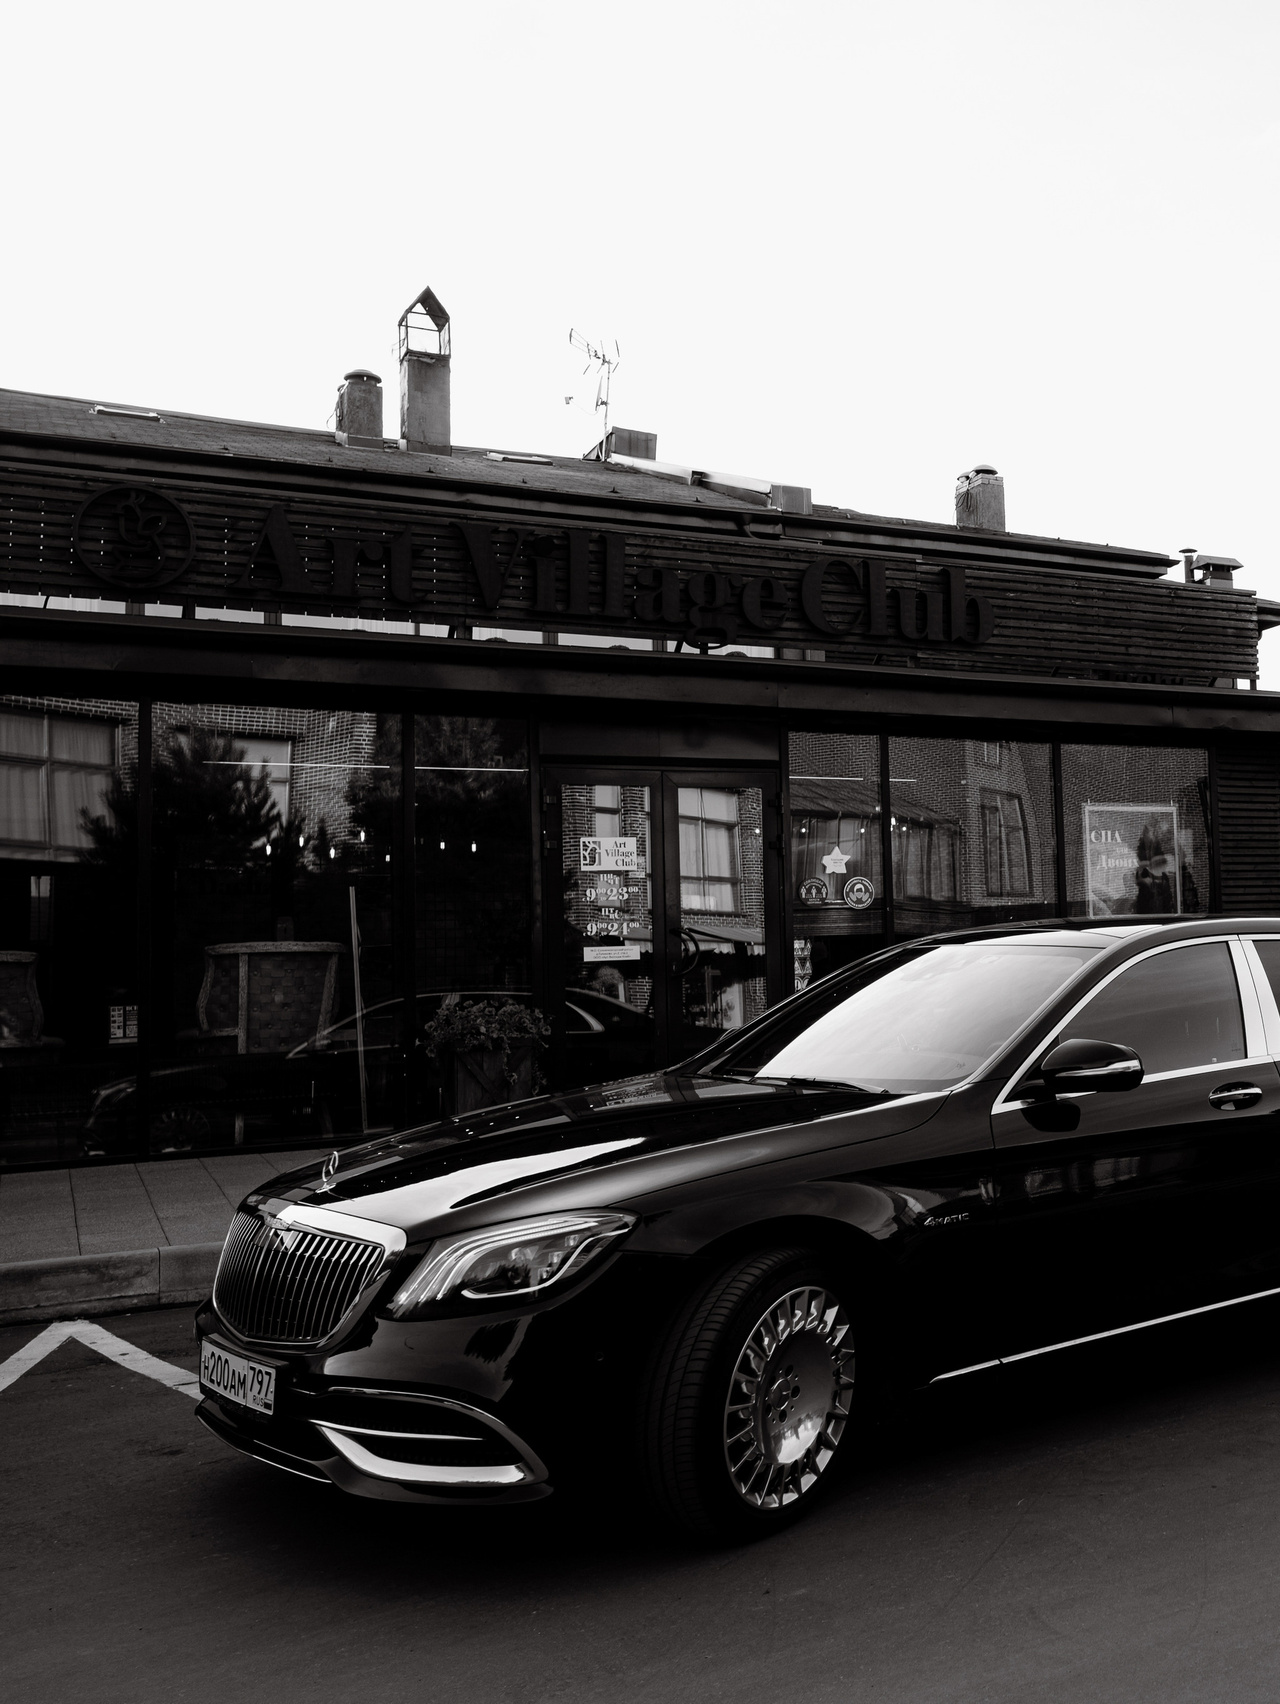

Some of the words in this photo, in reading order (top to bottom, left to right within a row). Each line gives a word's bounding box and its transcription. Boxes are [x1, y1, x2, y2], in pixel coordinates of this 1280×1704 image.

[228, 503, 428, 606] Art
[450, 521, 790, 649] Village
[801, 558, 996, 645] Club
[1090, 830, 1123, 843] СПА
[612, 840, 626, 848] Art
[604, 849, 635, 858] Village
[615, 858, 636, 867] Club
[923, 1212, 970, 1226] 4MATIC
[249, 1365, 272, 1398] 797
[252, 1394, 265, 1407] RUS
